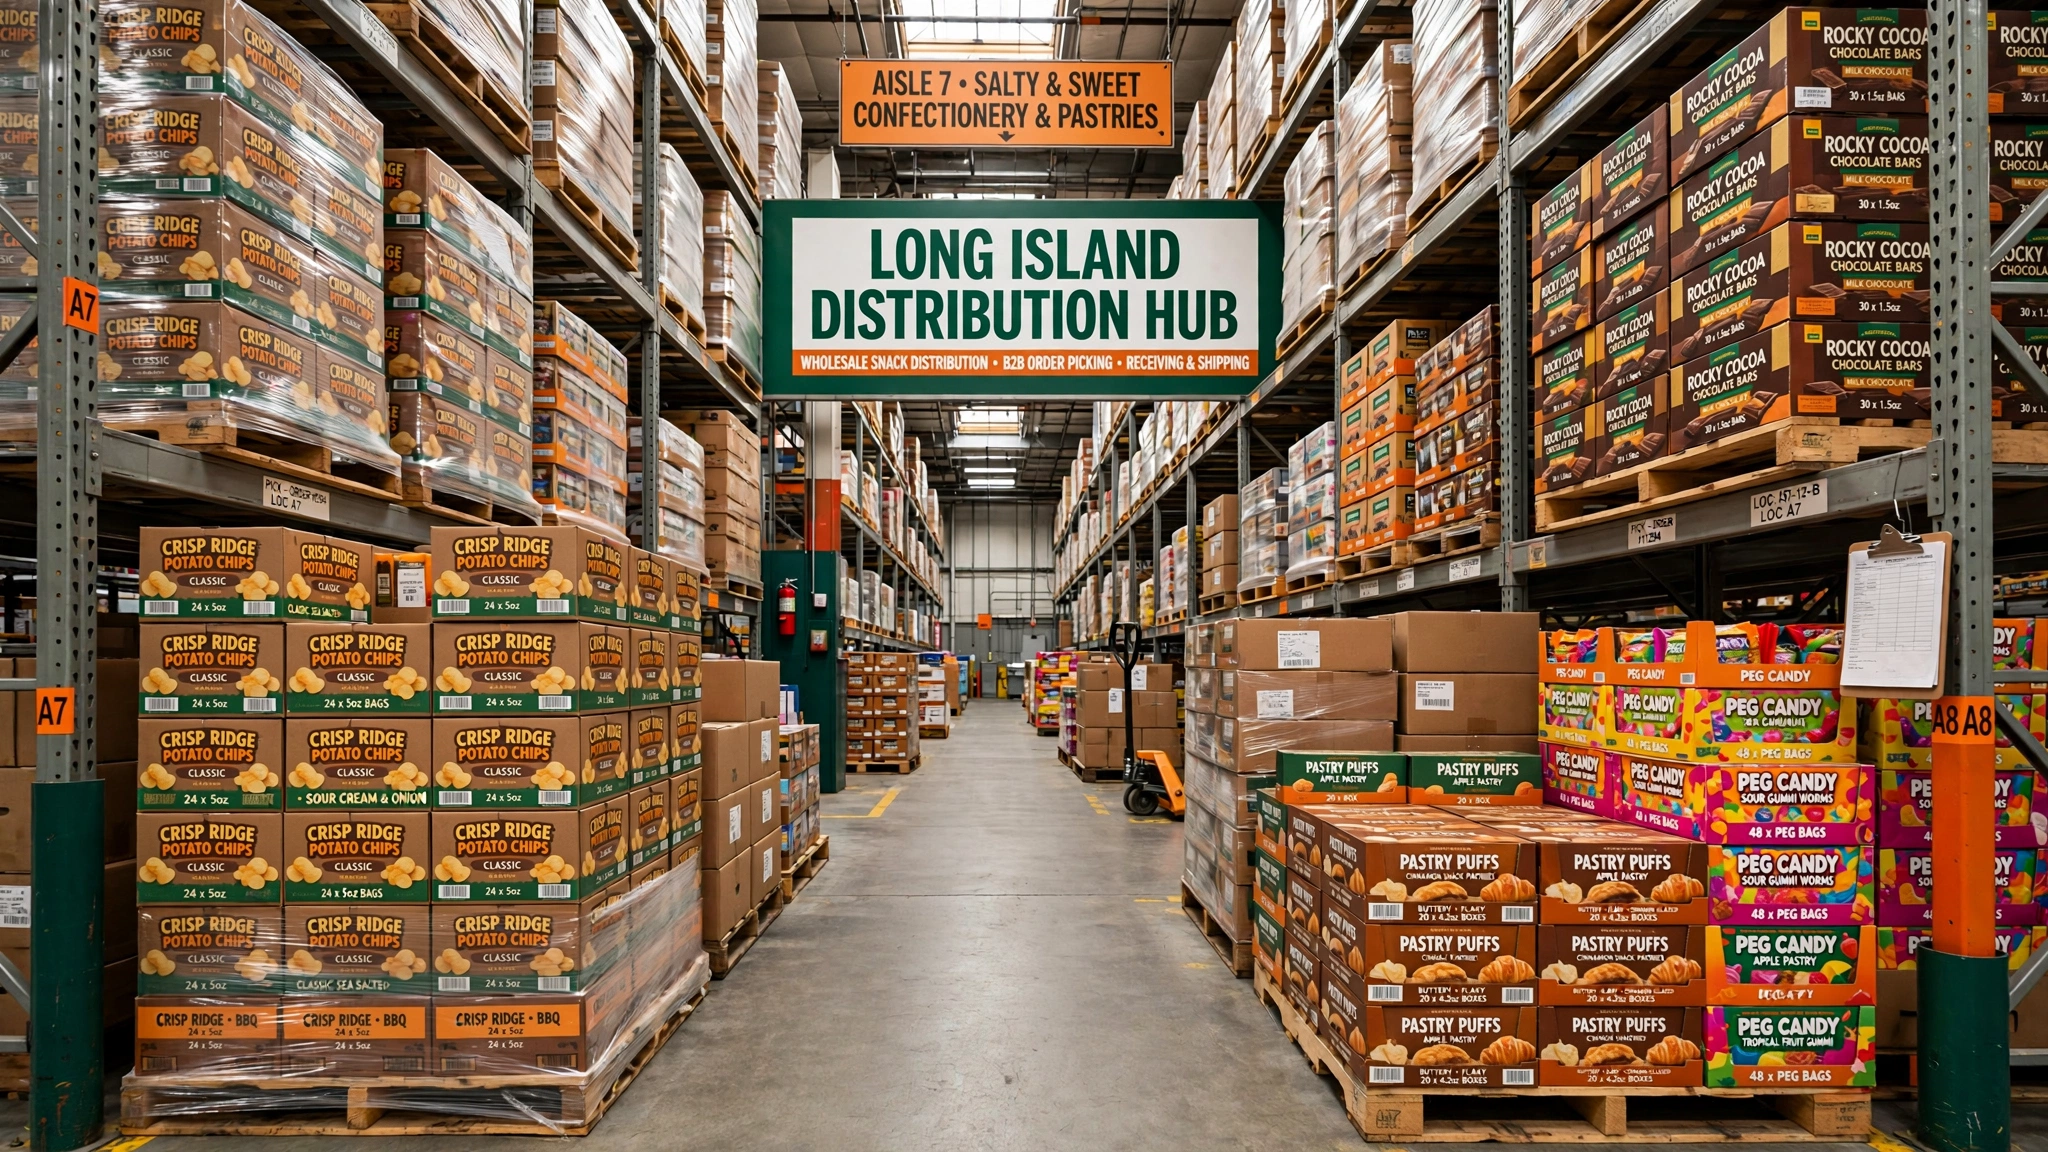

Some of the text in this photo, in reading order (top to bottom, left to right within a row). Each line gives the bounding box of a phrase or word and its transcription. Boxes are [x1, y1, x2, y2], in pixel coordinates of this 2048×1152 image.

[1824, 27, 1931, 45] ROCKY COCOA
[1830, 47, 1921, 59] CHOCOLATE BARS
[873, 70, 1140, 97] AISLE 7 SALTY & SWEET
[1686, 47, 1765, 113] ROCKY COCOA
[854, 102, 1158, 128] CONFECTIONERY & PASTRIES
[1825, 136, 1931, 154] ROCKY COCOA
[1995, 140, 2043, 157] ROCKY
[1831, 156, 1921, 168] CHOCOLATE BARS
[1859, 200, 1870, 210] 30
[1872, 202, 1878, 210] x
[872, 229, 1179, 280] LONG ISLAND
[1826, 241, 1931, 258] ROCKY COCOA
[1831, 261, 1922, 272] CHOCOLATE BARS
[70, 285, 95, 321] A7
[812, 290, 1237, 340] DISTRIBUTION HUB
[105, 316, 198, 337] CRISP RIDGE
[108, 331, 197, 349] POTATO CHIPS
[1827, 340, 1932, 357] ROCKY COCOA
[801, 355, 1249, 370] WHOLESALE SNACK DISTRIBUTION B2B ORDER PICKING RECEIVING & SHIPPING
[1687, 348, 1766, 391] ROCKY COCOA
[1832, 360, 1922, 371] CHOCOLATE BARS
[1607, 394, 1652, 421] ROCKY COCOA
[1860, 400, 1901, 410] 30 x 1.5oz
[271, 494, 301, 510] LOC A7
[1761, 503, 1801, 522] LOC A7
[162, 538, 256, 555] CRISP RIDGE
[455, 537, 549, 554] CRISP RIDGE
[164, 555, 254, 570] POTATO CHIPS
[457, 554, 547, 569] POTATO CHIPS
[189, 577, 226, 585] CLASSIC
[482, 575, 519, 584] CLASSIC
[192, 603, 202, 611] 24
[212, 603, 226, 612] 5oz
[310, 635, 404, 652] CRISP RIDGE
[457, 634, 551, 651] CRISP RIDGE
[312, 651, 402, 667] POTATO CHIPS
[459, 651, 549, 666] POTATO CHIPS
[337, 673, 374, 682] CLASSIC
[1741, 670, 1810, 683] PEG CANDY
[38, 696, 68, 725] A7
[324, 699, 336, 708] 24
[346, 699, 361, 708] 5oz
[365, 699, 389, 708] BAGS
[1726, 698, 1821, 716] PEG CANDY
[1933, 705, 1958, 735] A8
[1962, 706, 1991, 736] A8
[310, 730, 404, 747] CRISP RIDGE
[312, 747, 402, 762] POTATO CHIPS
[1306, 762, 1378, 773] PASTRY PUFFS
[1438, 763, 1518, 775] PASTRY PUFFS
[1738, 773, 1837, 792] PEG CANDY
[306, 792, 427, 805] SOUR CREAM & ONION
[1741, 794, 1764, 803] SOUR
[1799, 794, 1833, 803] WORMS
[456, 823, 550, 841] CRISP RIDGE
[1749, 827, 1762, 838] 48
[1775, 827, 1795, 838] PEG
[1799, 827, 1826, 838] BAGS
[458, 840, 548, 855] POTATO CHIPS
[1400, 854, 1499, 870] PASTRY PUFFS
[1575, 854, 1670, 870] PASTRY PUFFS
[1738, 855, 1838, 873] PEG CANDY
[1742, 875, 1834, 886] SOUR WORMS
[1572, 936, 1668, 951] PASTRY PUFFS
[1736, 935, 1837, 953] PEG CANDY
[1753, 956, 1816, 965] APPLE PASTRY
[156, 1013, 257, 1027] CRISP RIDGE BBQ
[456, 1013, 560, 1026] CRISP RIDGE BBQ
[1402, 1018, 1500, 1033] PASTRY PUFFS
[1738, 1018, 1839, 1036] PEG CANDY
[1750, 1071, 1831, 1081] 48 x PEG BAGS
